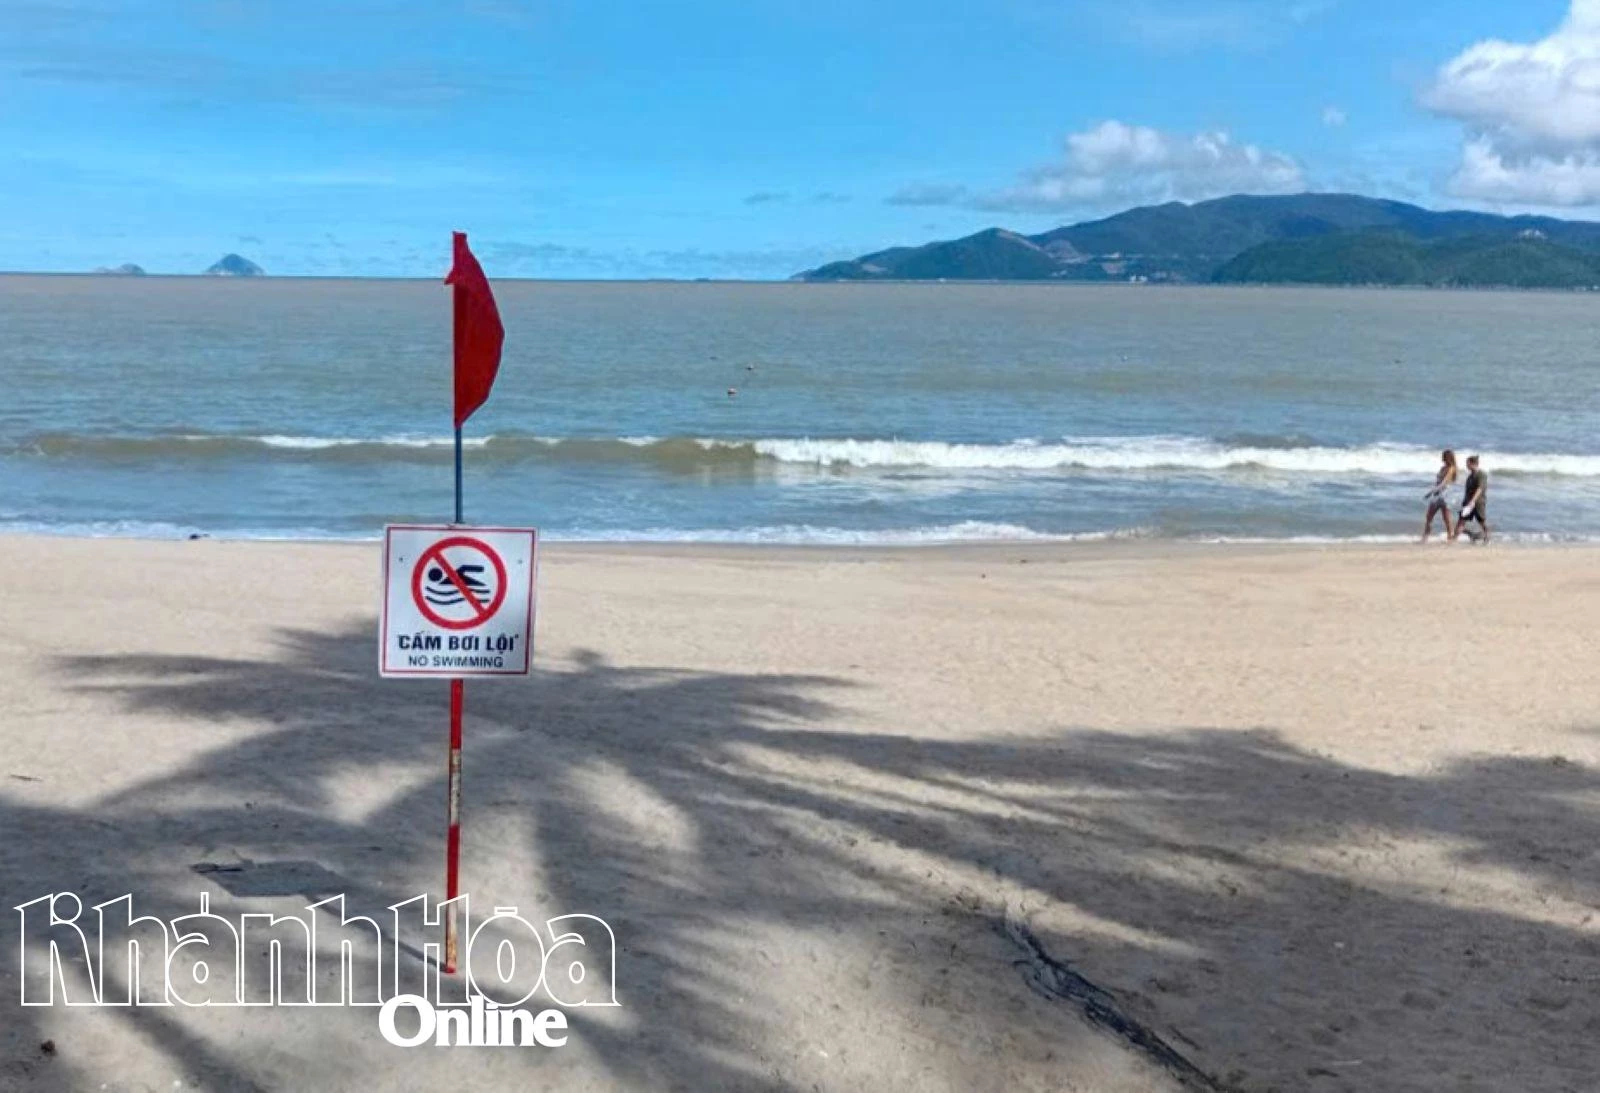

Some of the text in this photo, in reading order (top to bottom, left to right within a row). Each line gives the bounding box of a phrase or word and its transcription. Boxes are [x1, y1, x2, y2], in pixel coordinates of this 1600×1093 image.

[398, 630, 515, 656] CẤM BƠI LỘI
[408, 655, 504, 668] NO SWIMMING
